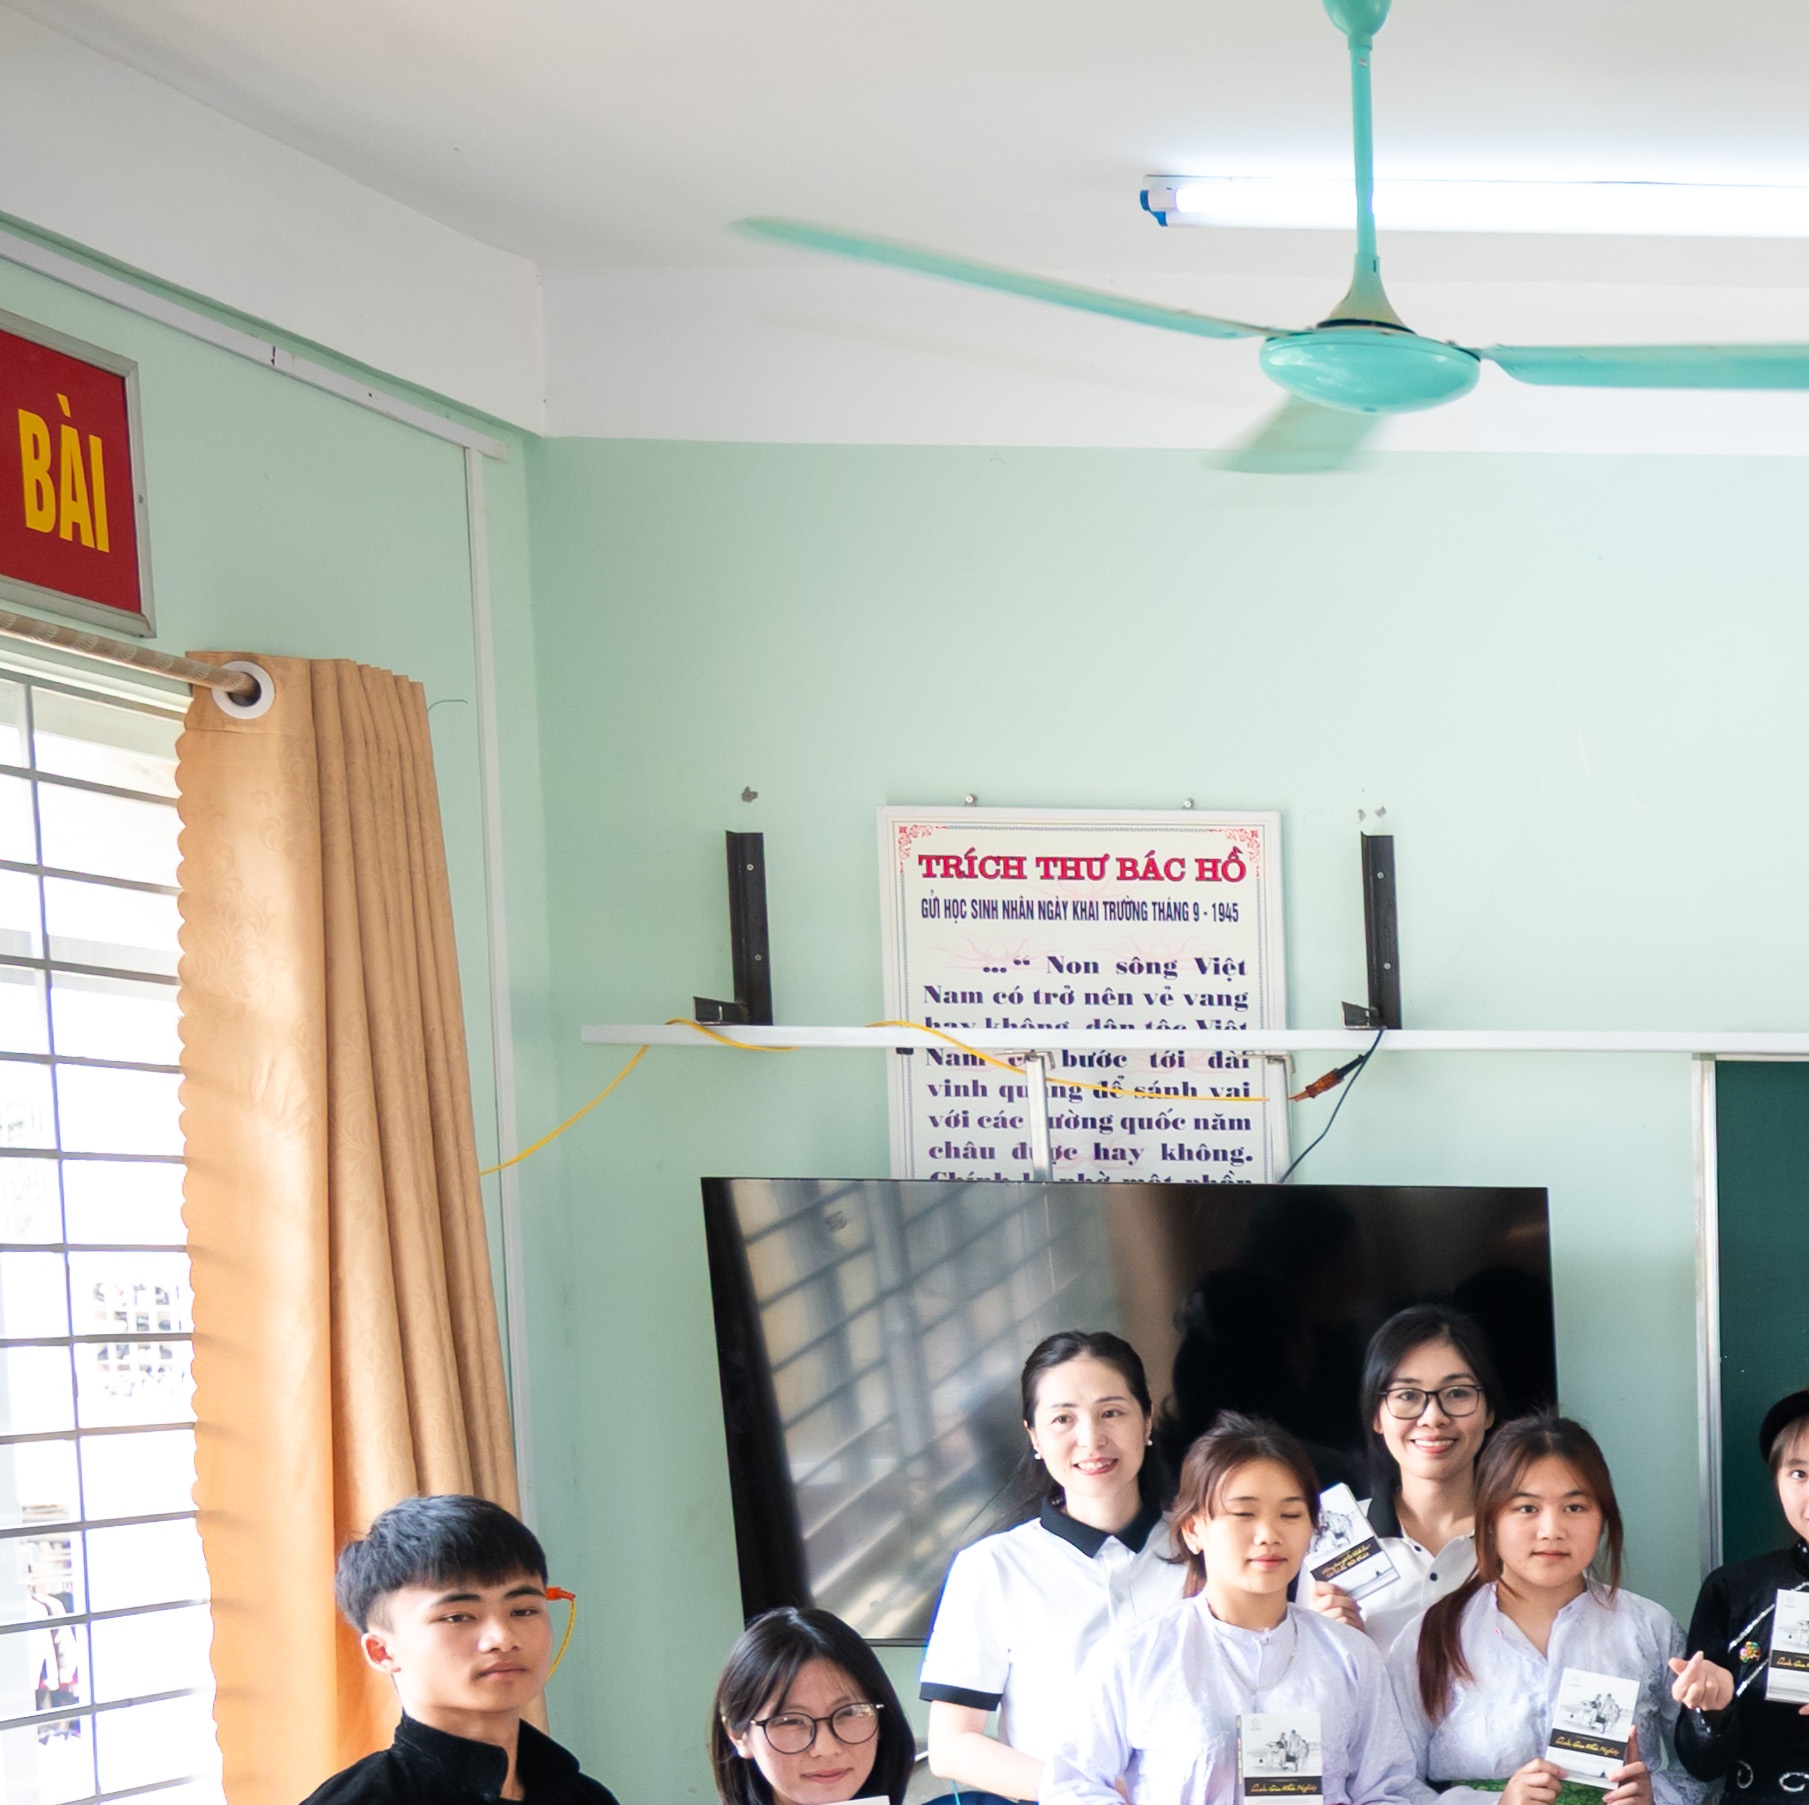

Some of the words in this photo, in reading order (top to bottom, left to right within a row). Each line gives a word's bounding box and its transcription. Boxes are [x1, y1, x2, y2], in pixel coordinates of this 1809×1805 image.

[18, 392, 109, 553] BÀI
[918, 847, 1027, 880] TRÍCH
[1035, 853, 1110, 881] THƯ
[1116, 850, 1186, 882] BÁC
[1195, 846, 1247, 883] HỒ
[944, 898, 967, 923] HỌC
[970, 899, 999, 920] SINH
[1002, 895, 1034, 921] NHÂN
[1038, 897, 1069, 921] NGÀY
[1072, 900, 1099, 921] KHAI
[1103, 896, 1148, 921] TRƯỜNG
[1152, 897, 1189, 921] THÁNG
[1192, 902, 1200, 921] 9
[1211, 902, 1239, 923] 1945
[1046, 955, 1101, 975] Non
[1114, 956, 1179, 979] sông
[1192, 956, 1248, 983] Việt
[922, 985, 984, 1005] Nam
[992, 985, 1025, 1005] có
[1032, 983, 1076, 1006] trở
[1083, 987, 1134, 1007] nên
[1143, 985, 1175, 1008] vẻ
[1183, 989, 1250, 1012] vang
[926, 1048, 986, 1066] Nam
[1062, 1049, 1128, 1068] bước
[1150, 1050, 1185, 1069] tới
[928, 1079, 988, 1097] vinh
[999, 1084, 1083, 1103] qung
[1134, 1080, 1197, 1099] sánh
[1210, 1081, 1250, 1098] vai
[928, 1109, 970, 1129] với
[977, 1109, 1024, 1129] các
[1047, 1109, 1114, 1135] ường
[1120, 1108, 1186, 1135] quốc
[1194, 1112, 1251, 1131] năm
[928, 1140, 996, 1160] châu
[1011, 1141, 1078, 1165] đợc
[1093, 1142, 1144, 1166] hay
[1161, 1142, 1253, 1167] không.
